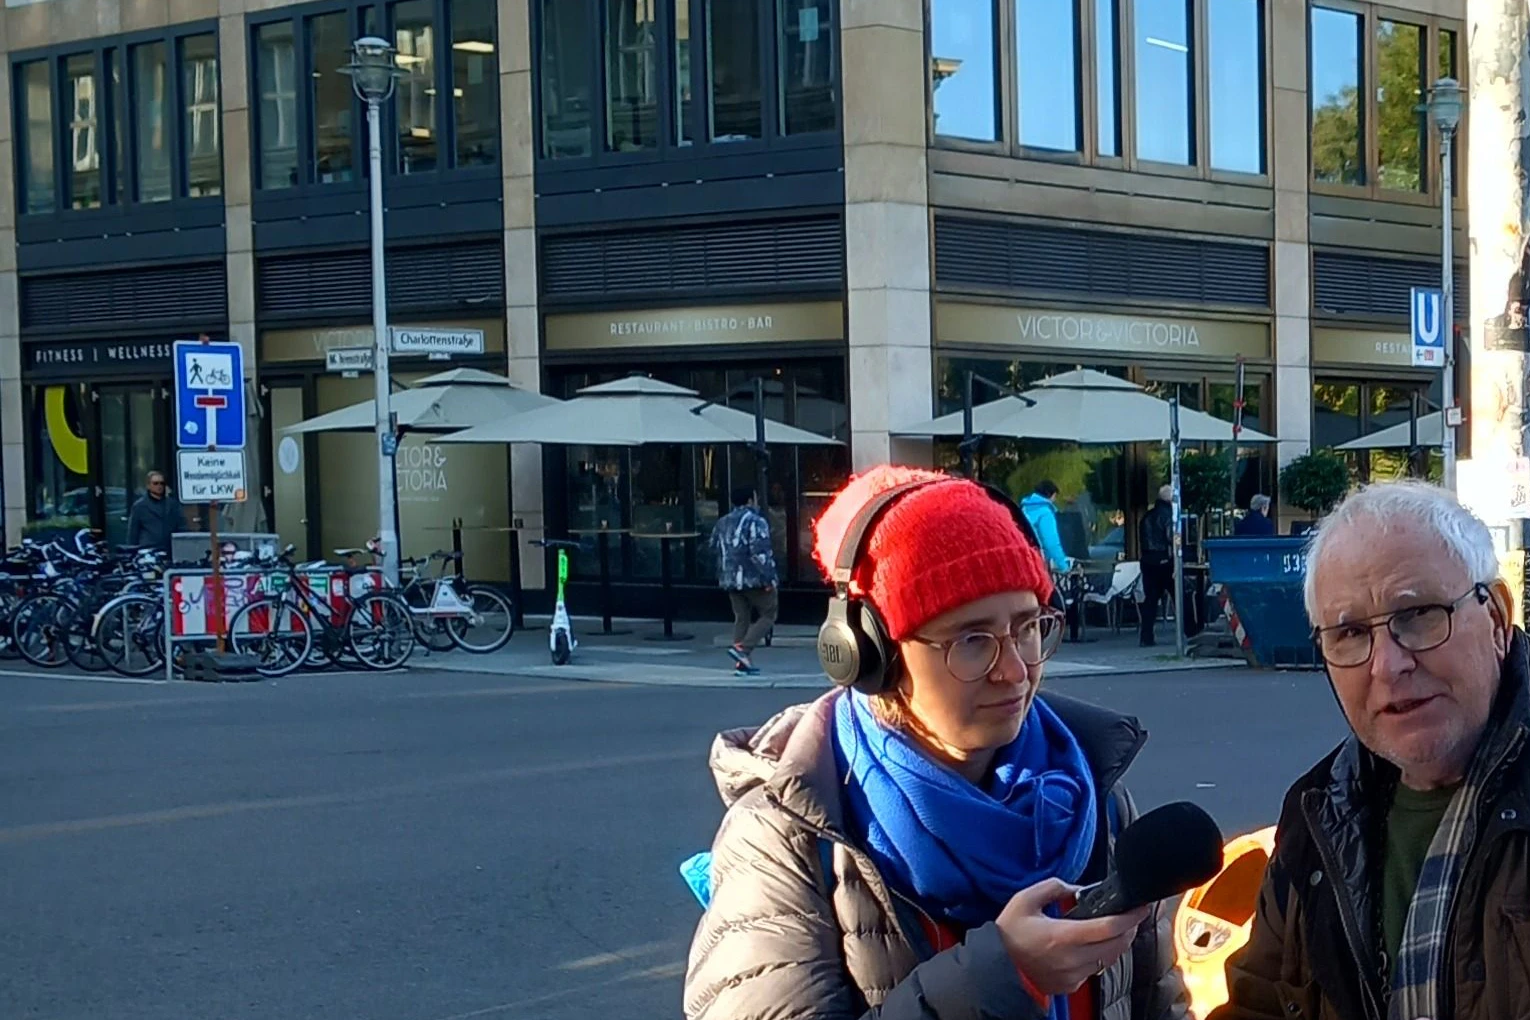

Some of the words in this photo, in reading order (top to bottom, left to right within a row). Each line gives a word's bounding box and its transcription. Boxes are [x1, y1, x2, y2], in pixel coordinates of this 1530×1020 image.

[610, 320, 684, 336] RESTAURANT
[694, 317, 738, 331] BISTRO
[748, 316, 773, 329] BAR
[1417, 292, 1440, 344] U
[400, 332, 474, 348] Charlottenstraße
[1375, 341, 1412, 354] RESTA
[35, 348, 84, 363] FITNESS
[107, 344, 170, 359] WELLNESS
[197, 456, 225, 467] Keine
[192, 484, 206, 495] für
[210, 484, 234, 495] LKW
